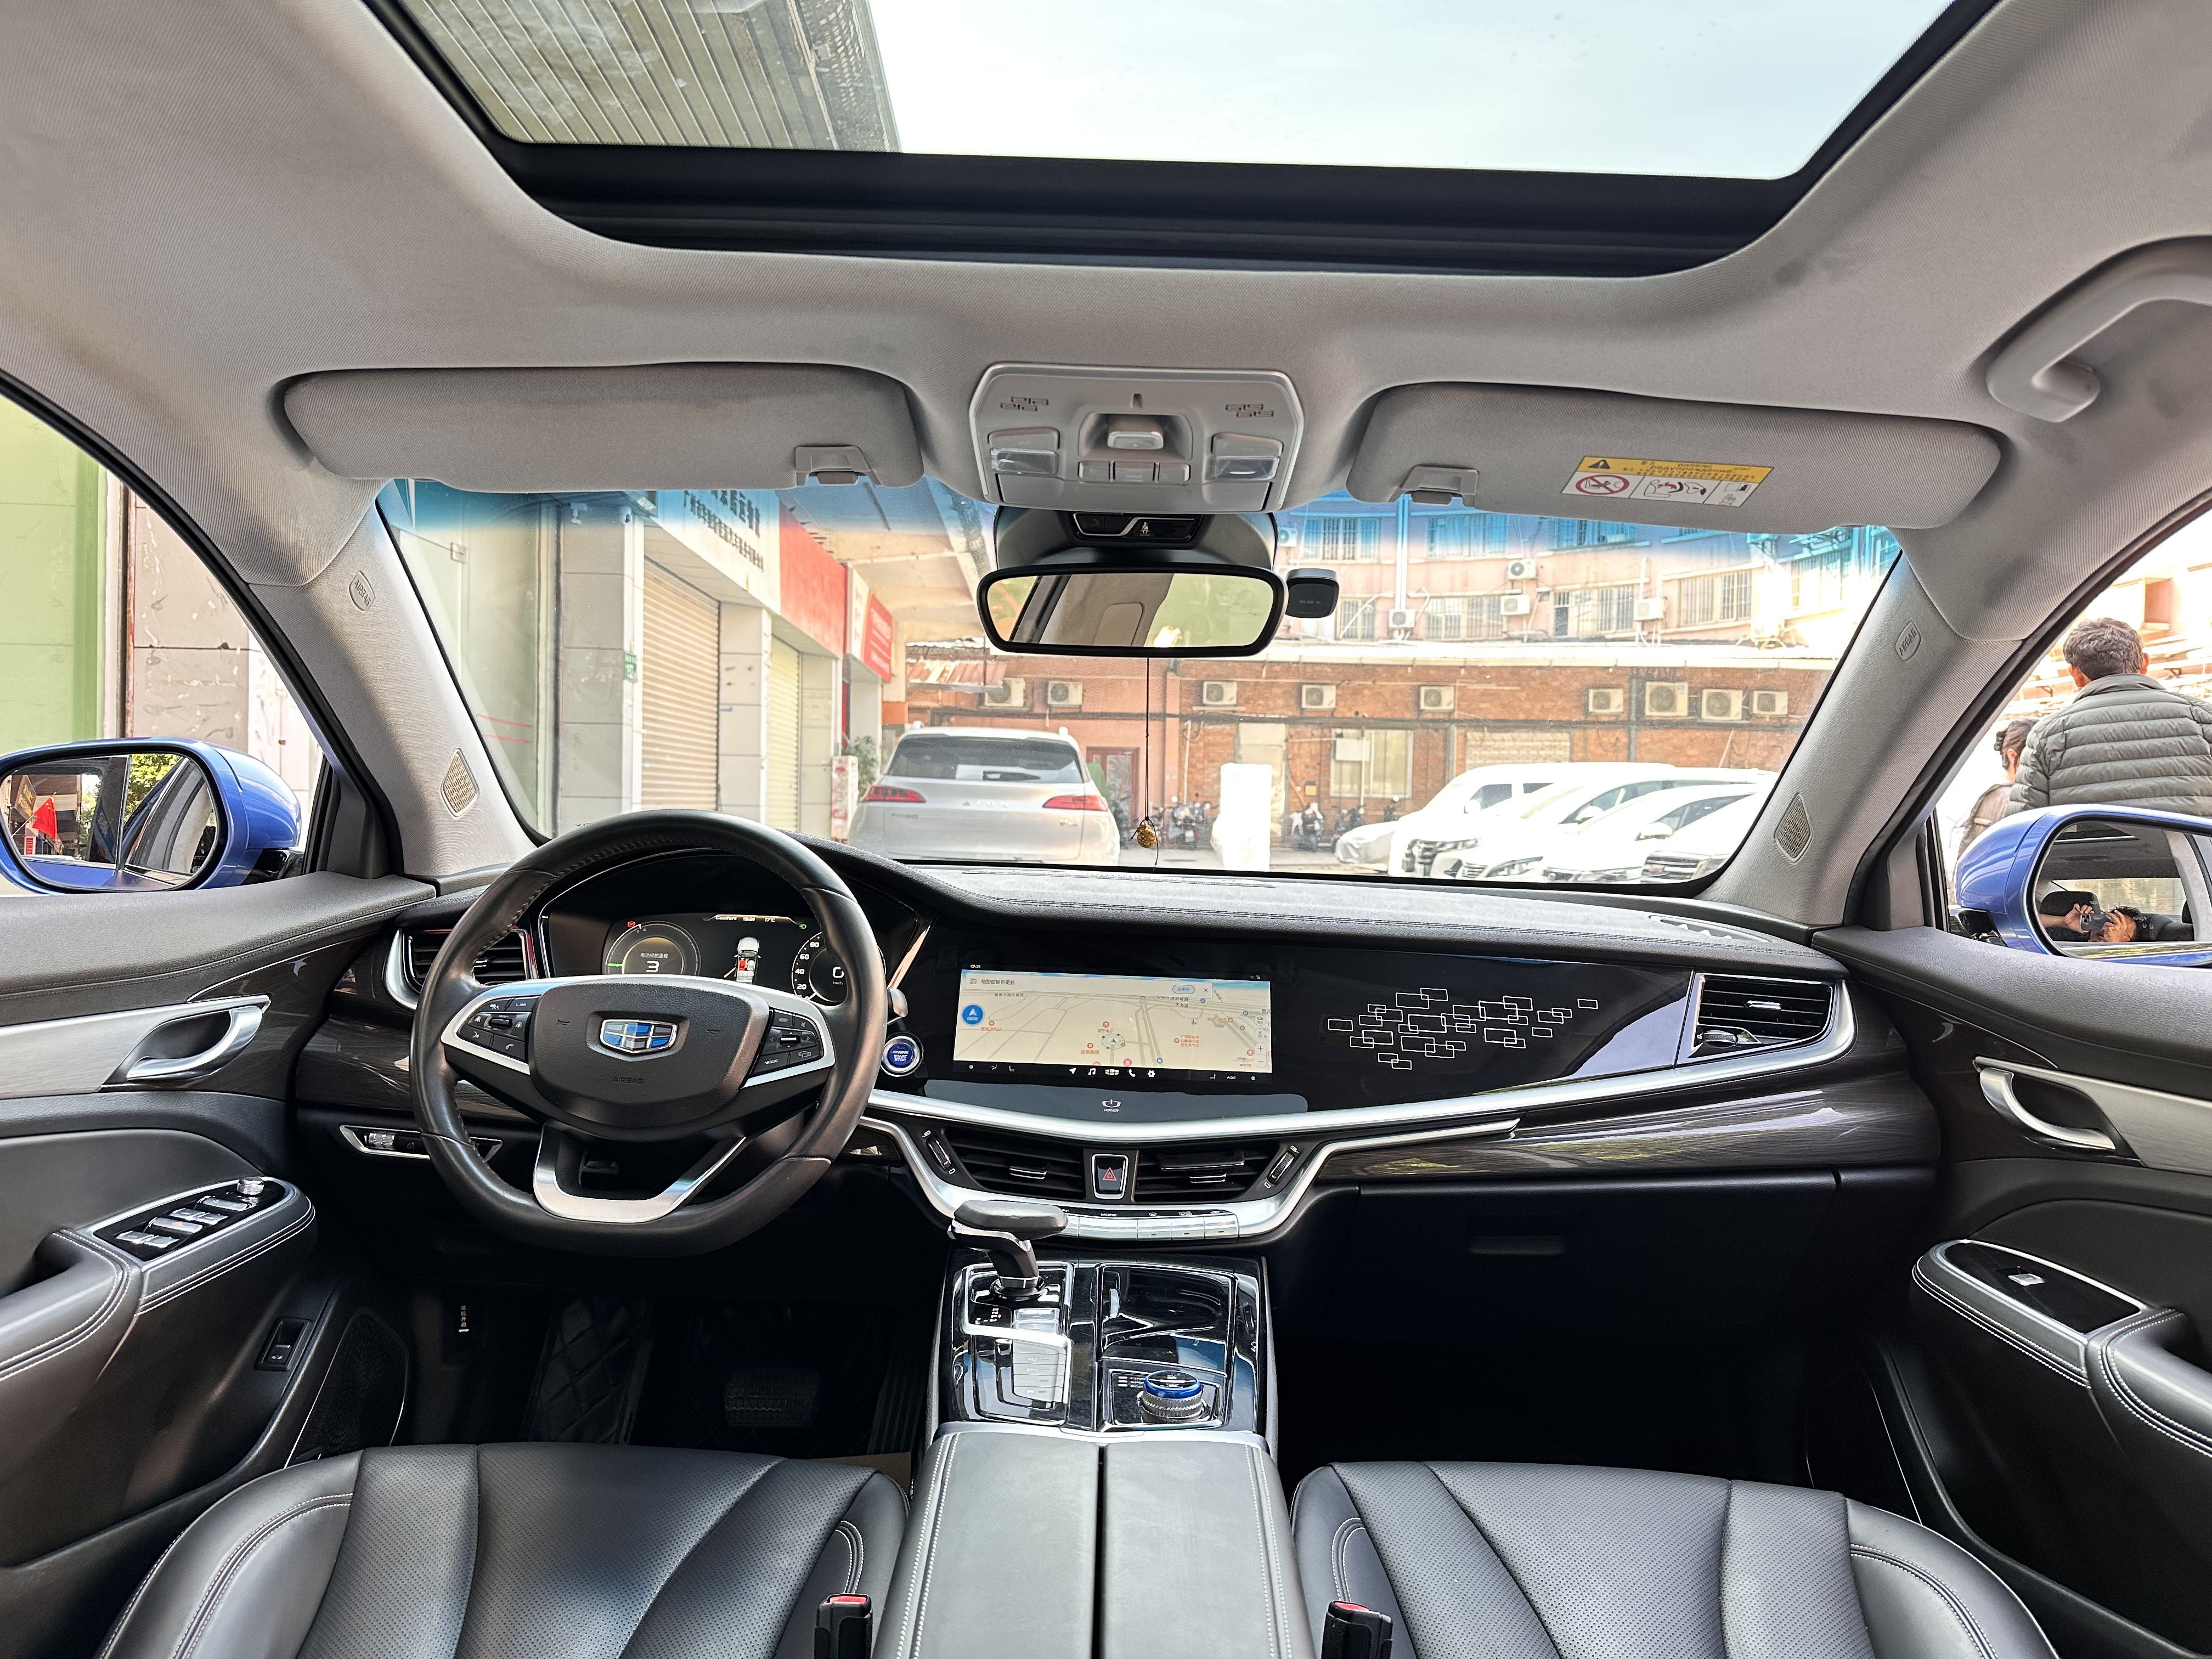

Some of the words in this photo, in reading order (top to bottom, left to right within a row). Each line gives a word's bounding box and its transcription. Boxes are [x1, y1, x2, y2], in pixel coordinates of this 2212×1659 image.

[354, 579, 371, 607] AIRBAG
[1899, 627, 1917, 657] AIRBAG
[646, 961, 660, 973] 3
[832, 967, 844, 978] 0
